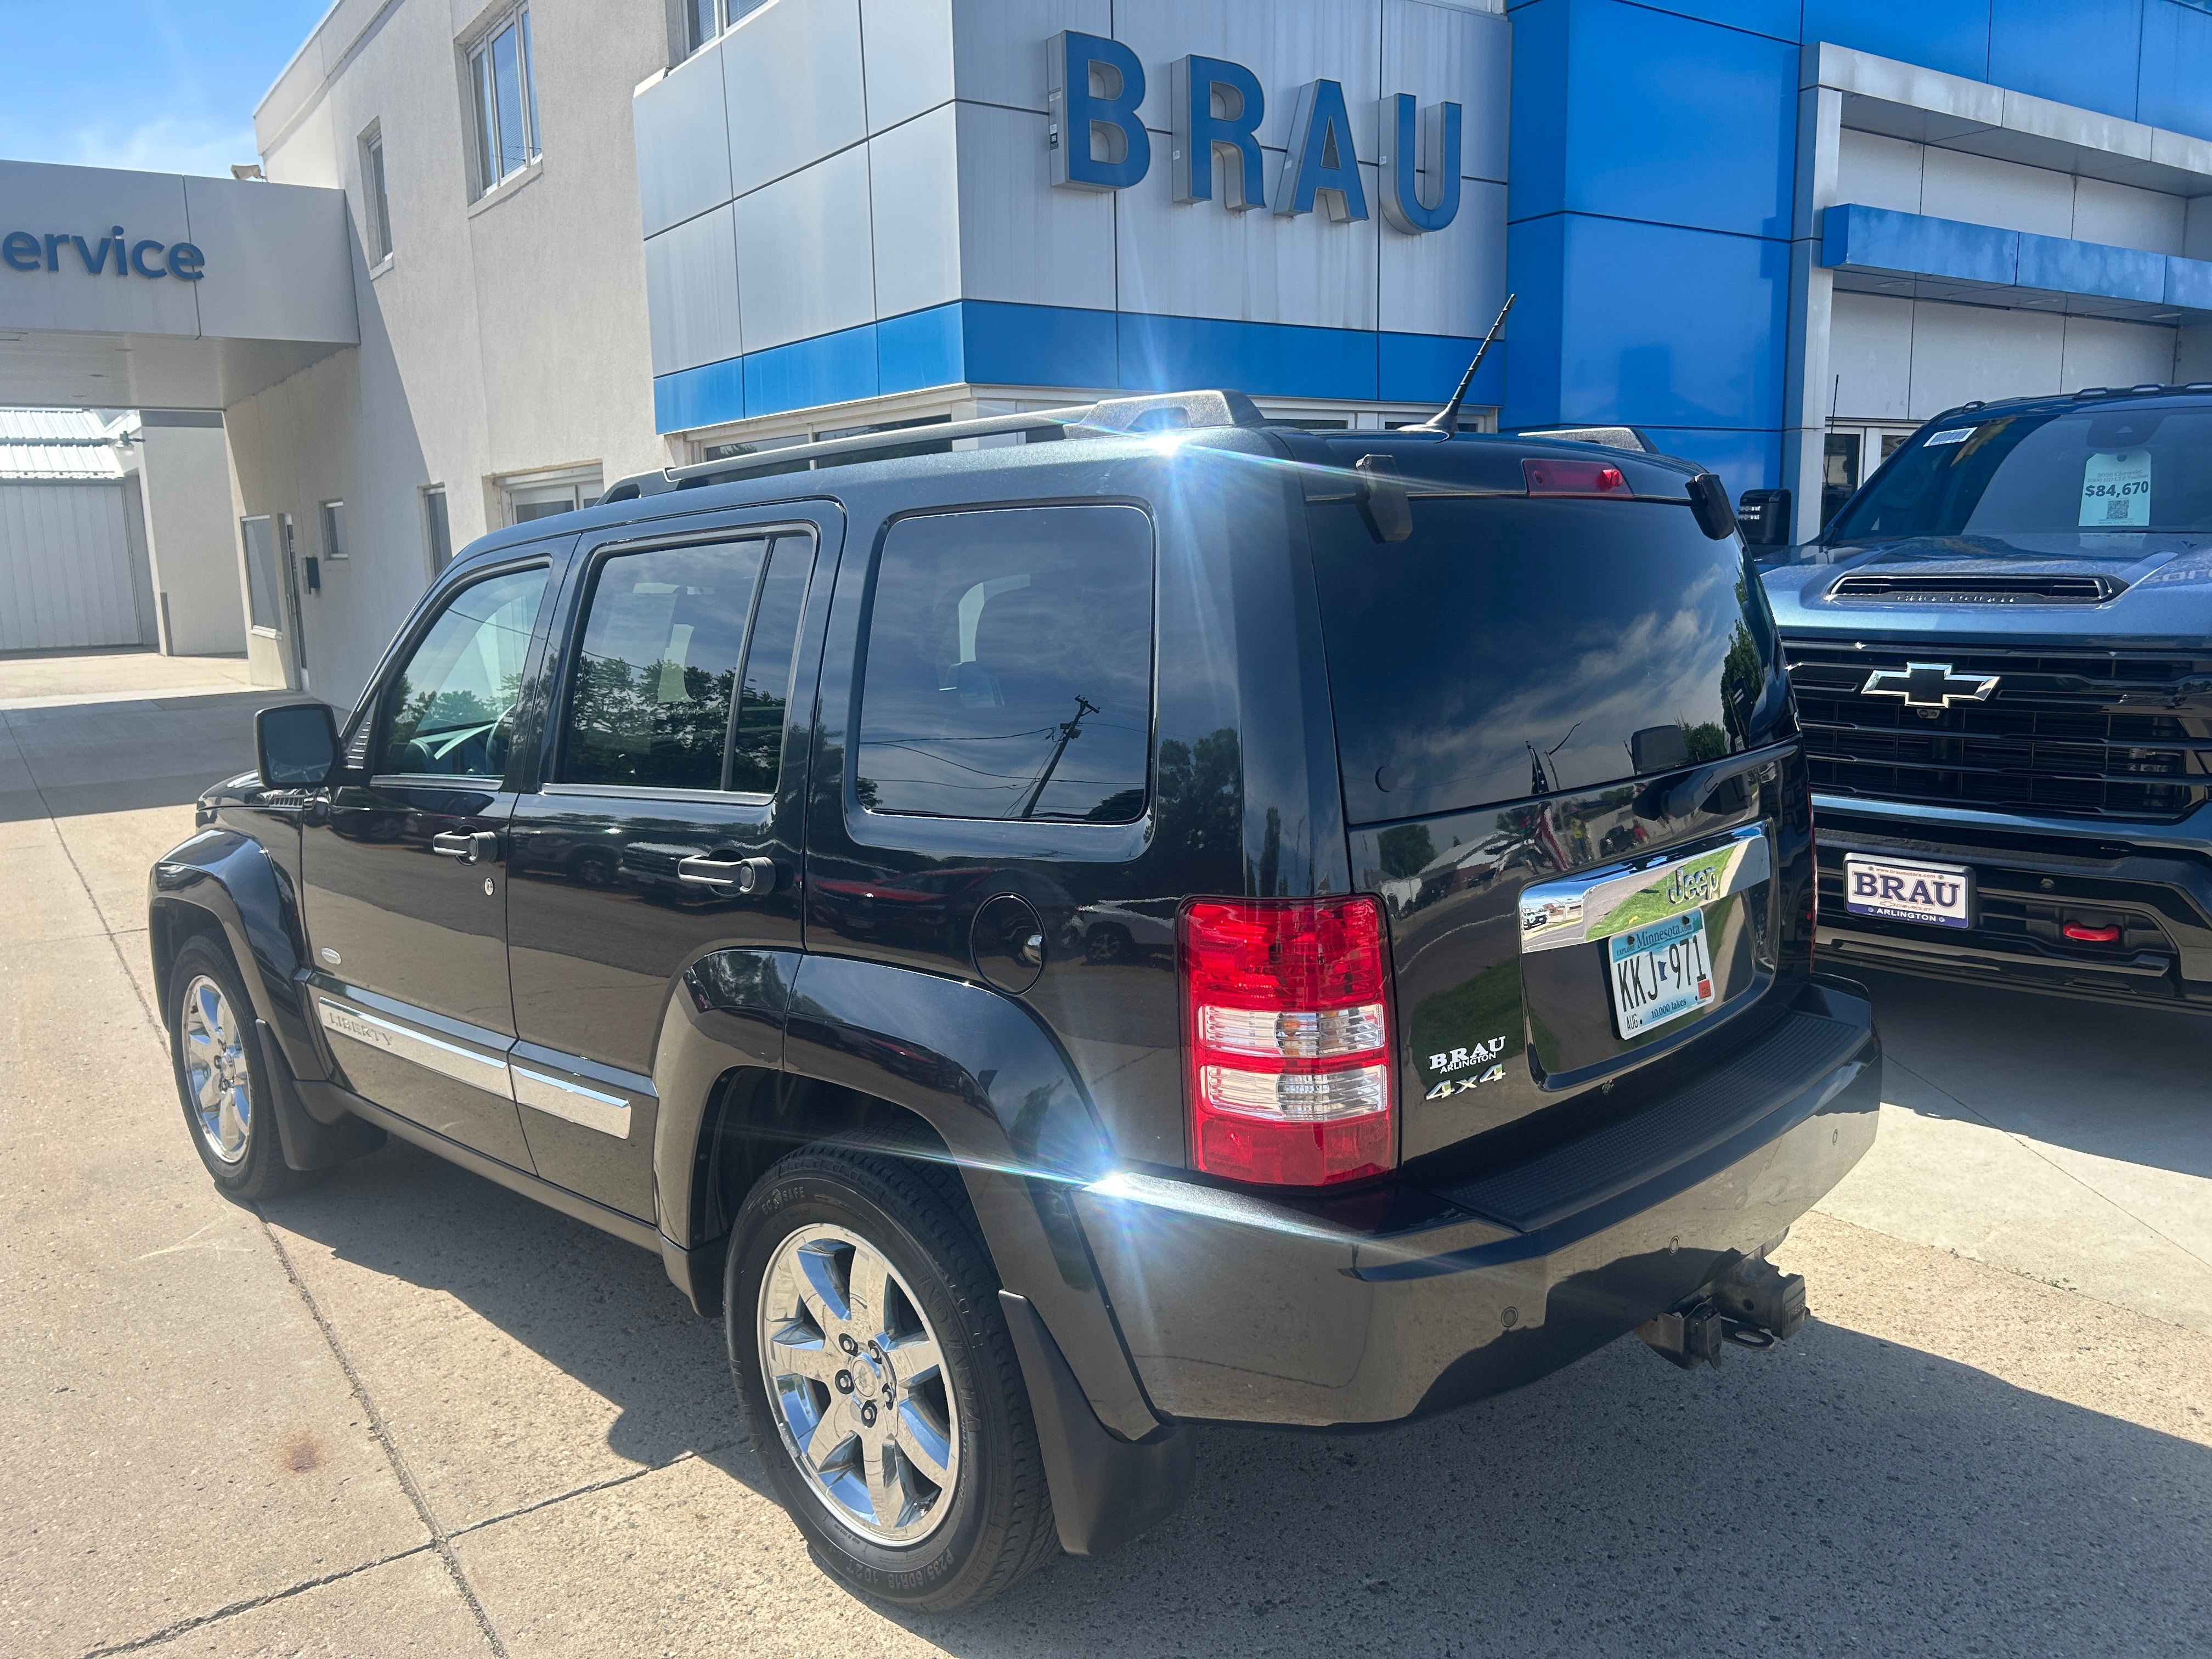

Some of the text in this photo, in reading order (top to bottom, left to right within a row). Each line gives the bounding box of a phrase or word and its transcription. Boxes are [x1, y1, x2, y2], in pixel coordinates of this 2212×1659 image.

[1048, 30, 1462, 235] BRAU
[1, 225, 206, 281] ervice
[2085, 481, 2149, 498] $84,670
[1668, 867, 1718, 904] Jeep
[1876, 867, 1936, 879] www.braumotors.com
[1852, 871, 1960, 909] BRAU
[1876, 908, 1936, 922] ARLINGTON
[1895, 904, 1932, 912] CHEVROLET
[1617, 935, 1707, 1012] KKJ 971
[1626, 998, 1686, 1031] AUG 10,000 lakes
[1429, 1036, 1506, 1070] BRAU
[1440, 1052, 1497, 1074] ARLINGTON
